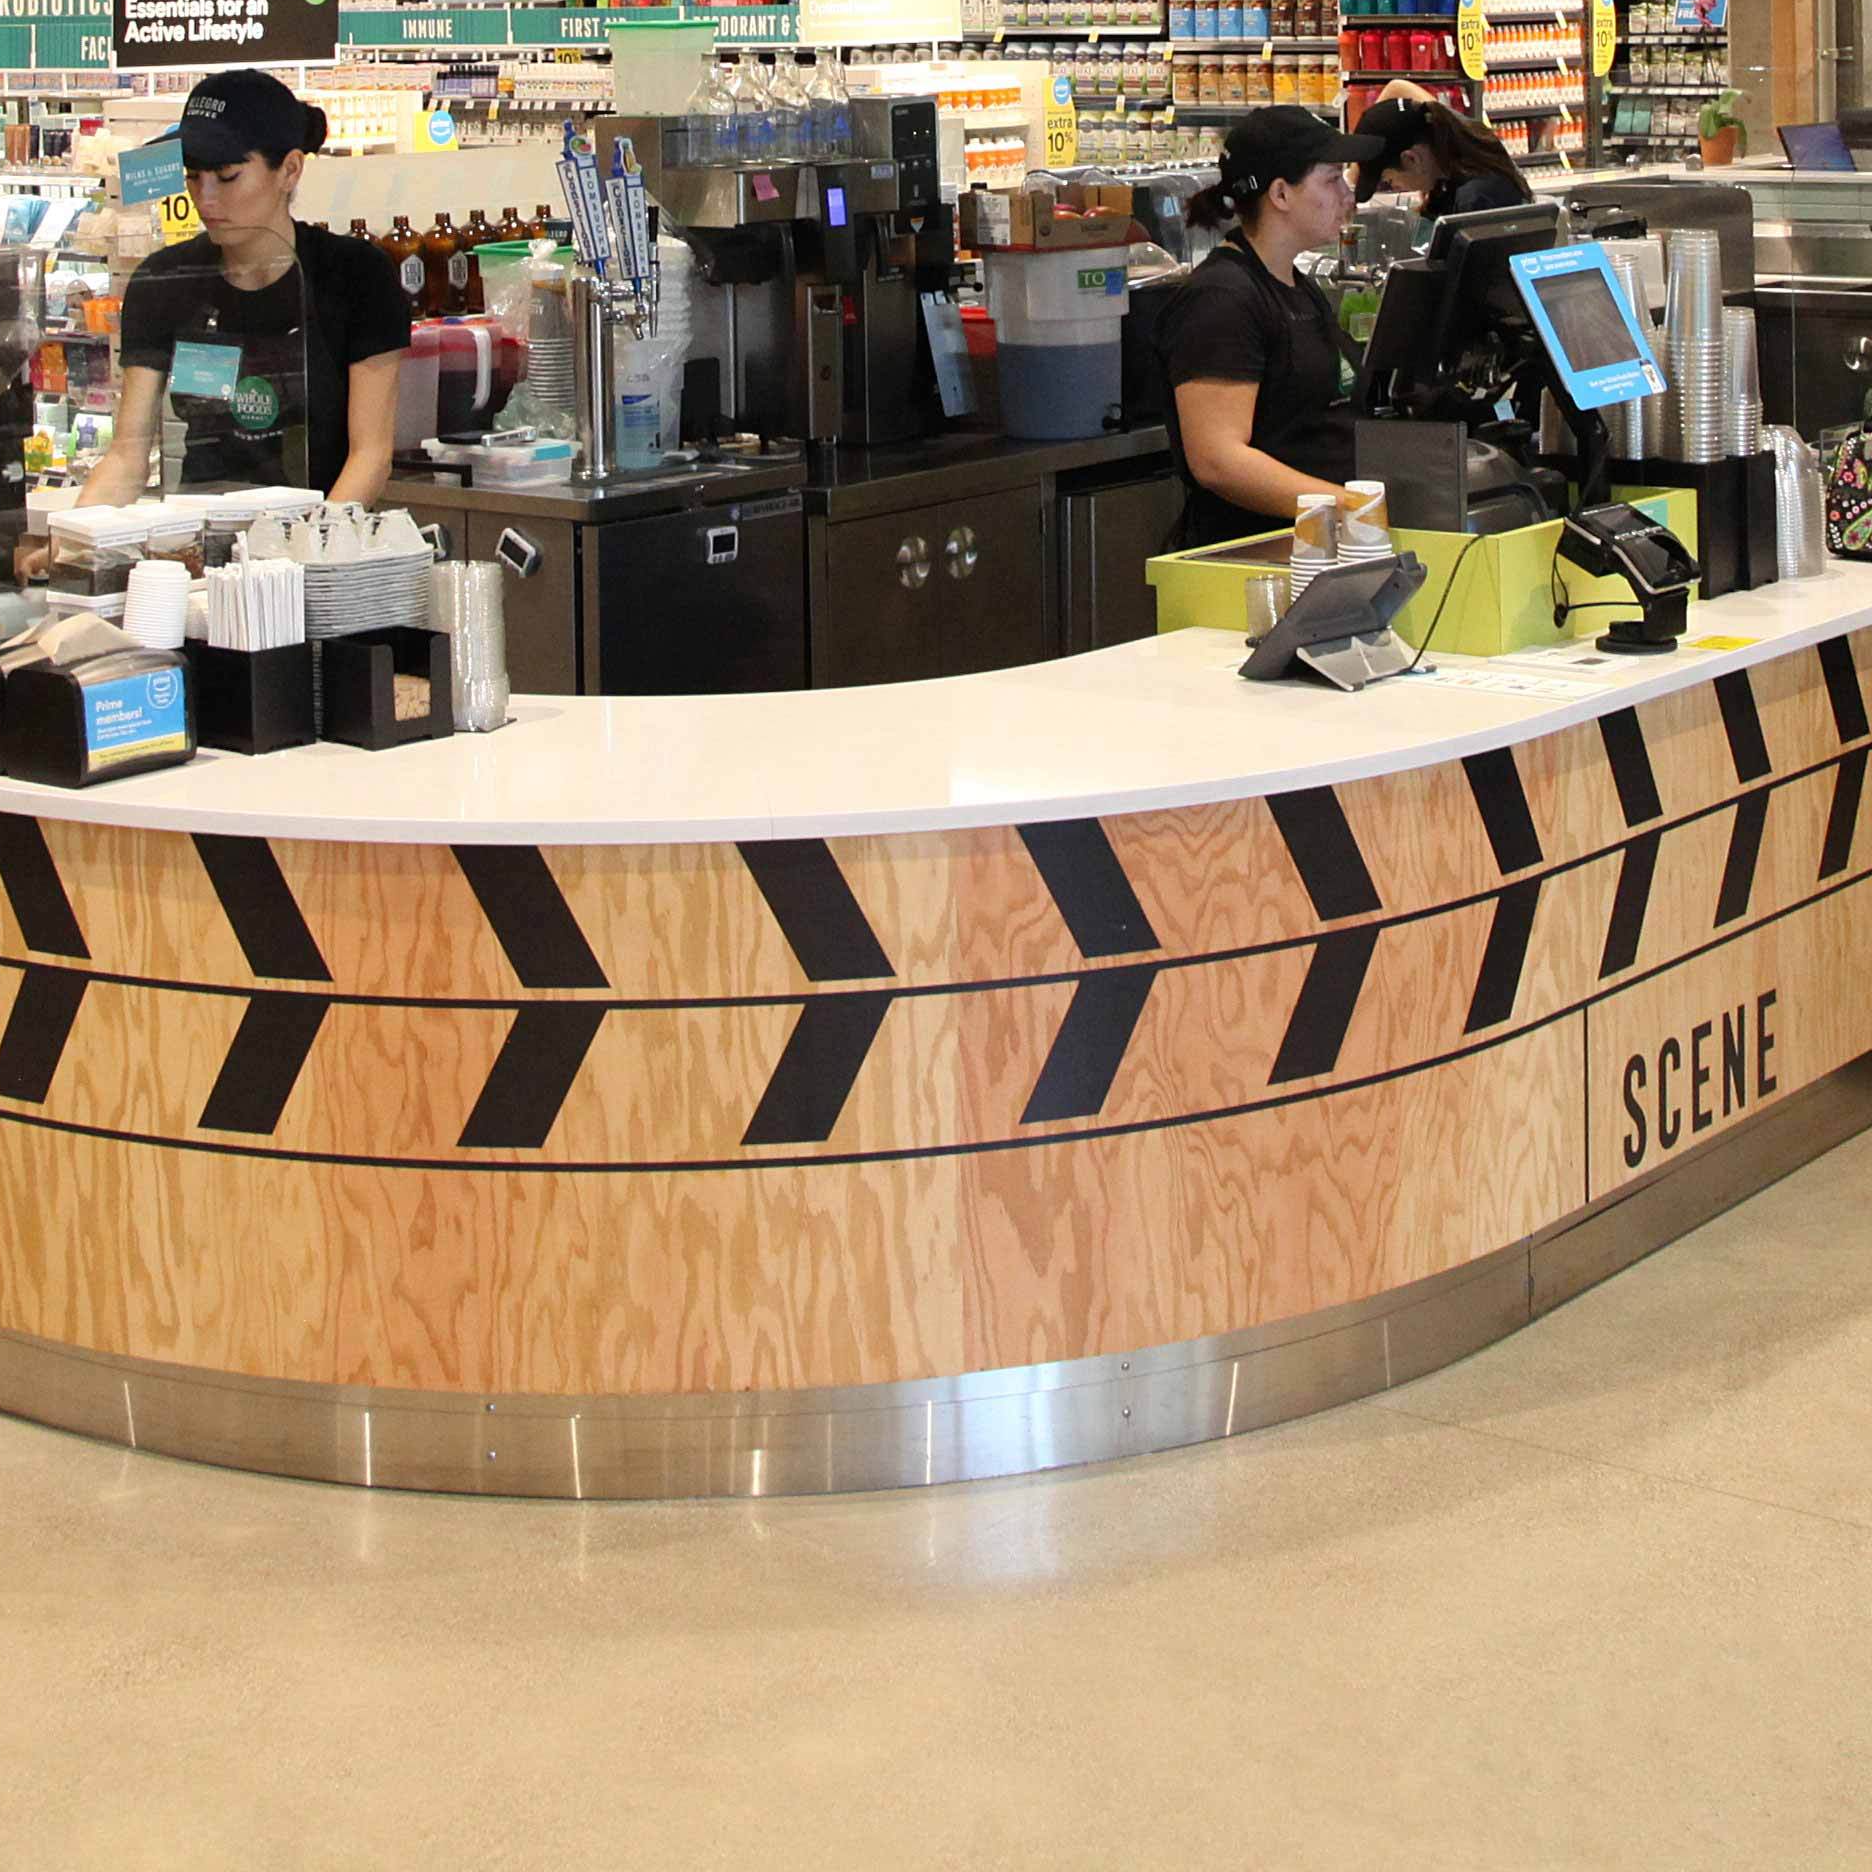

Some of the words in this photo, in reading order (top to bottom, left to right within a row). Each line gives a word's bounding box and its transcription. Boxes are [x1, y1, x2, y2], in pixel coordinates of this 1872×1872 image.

[124, 20, 186, 43] Active
[188, 17, 264, 45] Lifestyle
[402, 18, 453, 39] IMMUNE
[561, 18, 601, 38] FIRST
[1461, 19, 1480, 31] extra
[81, 37, 113, 61] FACI
[1461, 32, 1481, 52] 10%
[189, 96, 226, 113] ALLEGRO
[1047, 117, 1073, 130] extra
[1047, 132, 1074, 153] 10%
[235, 393, 273, 405] WHOLE
[236, 403, 272, 416] FOODS
[95, 698, 123, 713] Prime
[96, 706, 143, 726] members!
[1622, 988, 1778, 1169] SCENE
